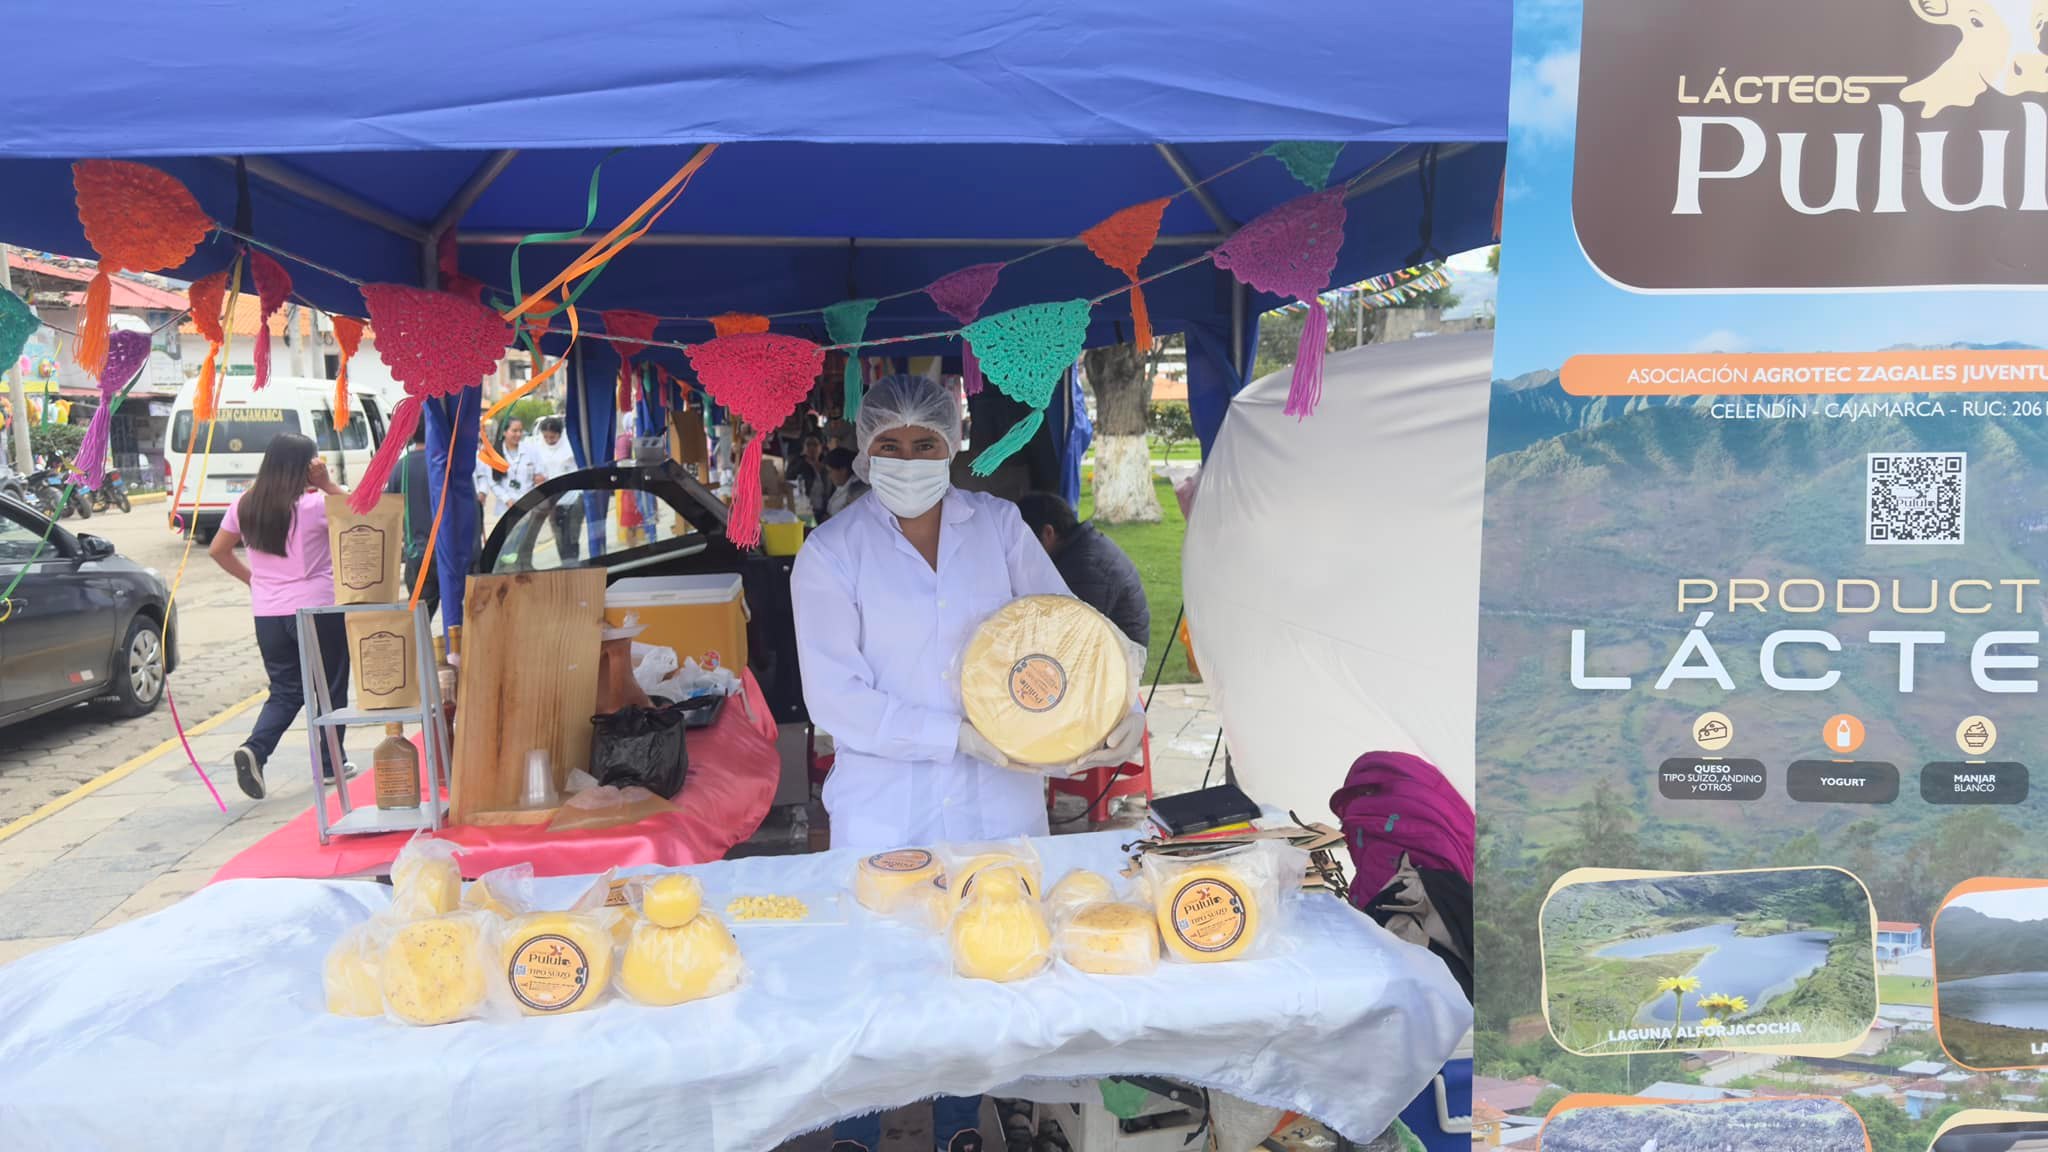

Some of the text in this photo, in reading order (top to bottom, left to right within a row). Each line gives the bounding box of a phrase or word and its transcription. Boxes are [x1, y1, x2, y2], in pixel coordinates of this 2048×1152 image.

[1678, 67, 1907, 103] LÁCTEOS
[1627, 364, 1748, 383] ASOCIACIÓN
[1752, 367, 1851, 383] AGROTEC
[1857, 365, 1957, 382] ZAGALES
[1711, 399, 1806, 419] CELENDÍN
[1825, 400, 1945, 422] CAJAMARCA
[1963, 401, 2006, 417] RUC:
[1677, 579, 2040, 613] PRODUCT
[1570, 611, 2040, 692] LÁCTE
[1694, 765, 1730, 774] QUESO
[1664, 774, 1762, 783] TIPO SUIZO, ANDINO
[1820, 777, 1866, 787] YOGURT
[1954, 775, 1996, 785] MANJAR
[1699, 784, 1732, 792] OTROS
[1954, 784, 1995, 792] BLANCO
[1609, 1022, 1801, 1041] LAGUNA ALFORJACOCHA
